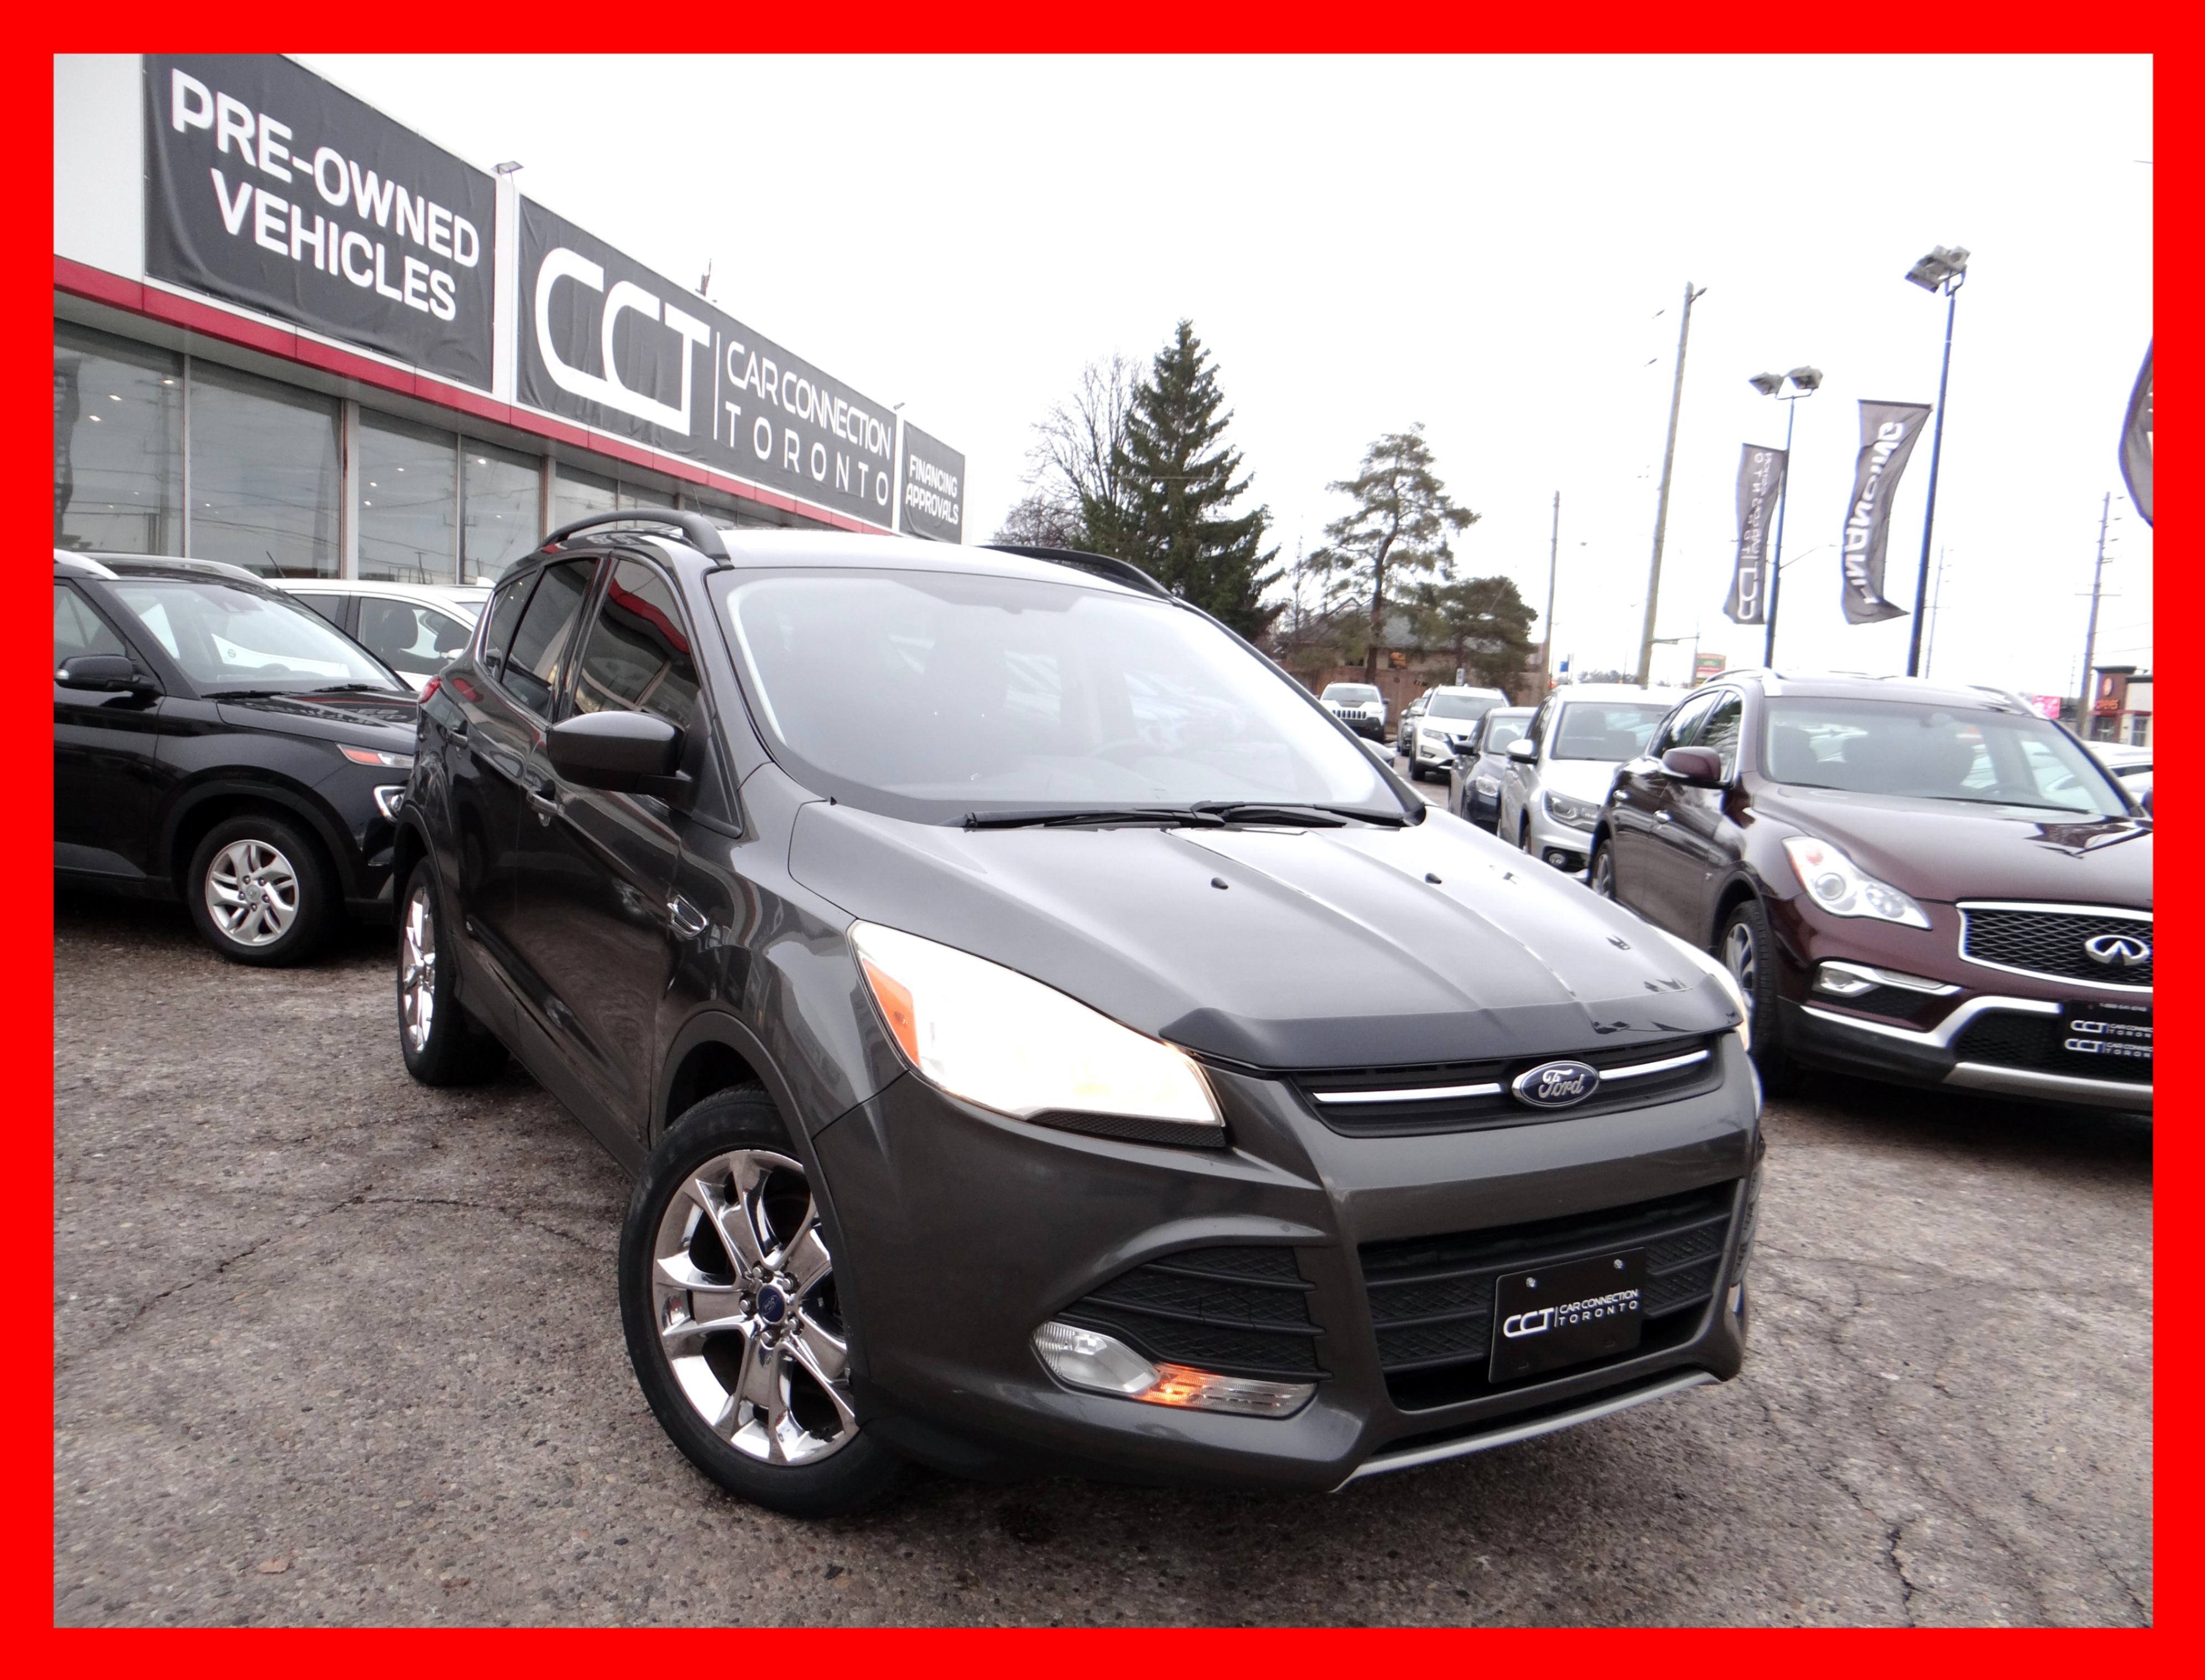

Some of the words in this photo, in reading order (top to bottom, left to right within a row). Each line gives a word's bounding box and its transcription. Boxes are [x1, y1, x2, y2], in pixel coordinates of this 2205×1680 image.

[171, 68, 480, 268] PRE-OWNED
[211, 168, 457, 321] VEHICLES
[535, 247, 711, 436] CCT
[727, 341, 779, 406] CAR
[782, 371, 891, 460] CONNECTION
[725, 401, 889, 506] TORONTO
[909, 454, 958, 498] FINANCING
[905, 483, 959, 525] APPROVALS
[2064, 1038, 2105, 1052] CCT
[2070, 1020, 2108, 1033] CCT
[1538, 1069, 1585, 1098] Ford
[1559, 1302, 1581, 1314] CAR
[1582, 1289, 1639, 1309] CONNECTION
[1559, 1300, 1638, 1325] TORONTO
[1503, 1308, 1554, 1338] CCT
